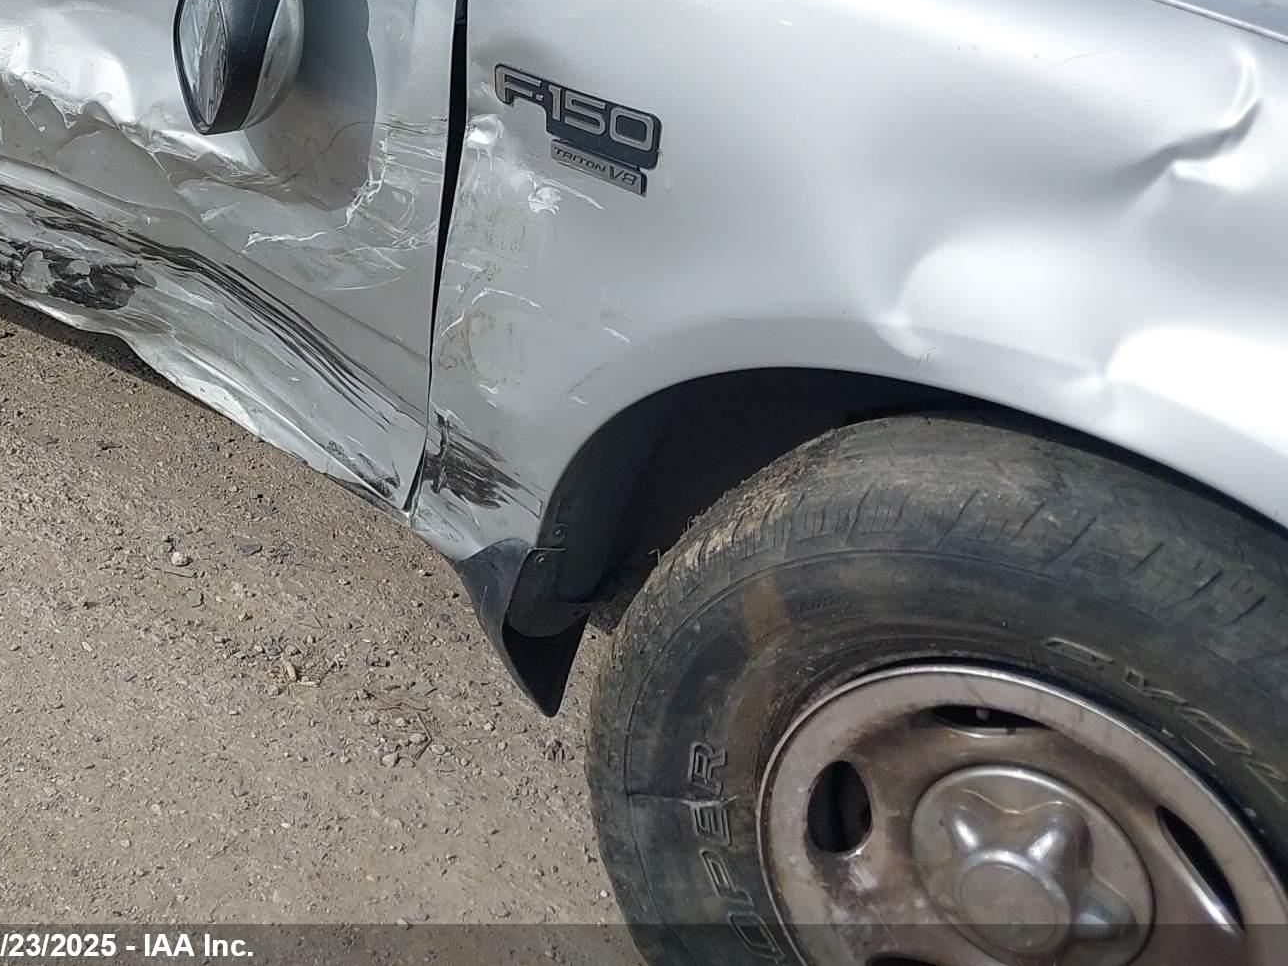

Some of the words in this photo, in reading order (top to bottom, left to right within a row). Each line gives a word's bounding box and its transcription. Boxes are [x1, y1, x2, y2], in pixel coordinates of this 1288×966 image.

[495, 65, 654, 152] F-150
[553, 145, 607, 173] TRITON
[609, 165, 638, 185] V8
